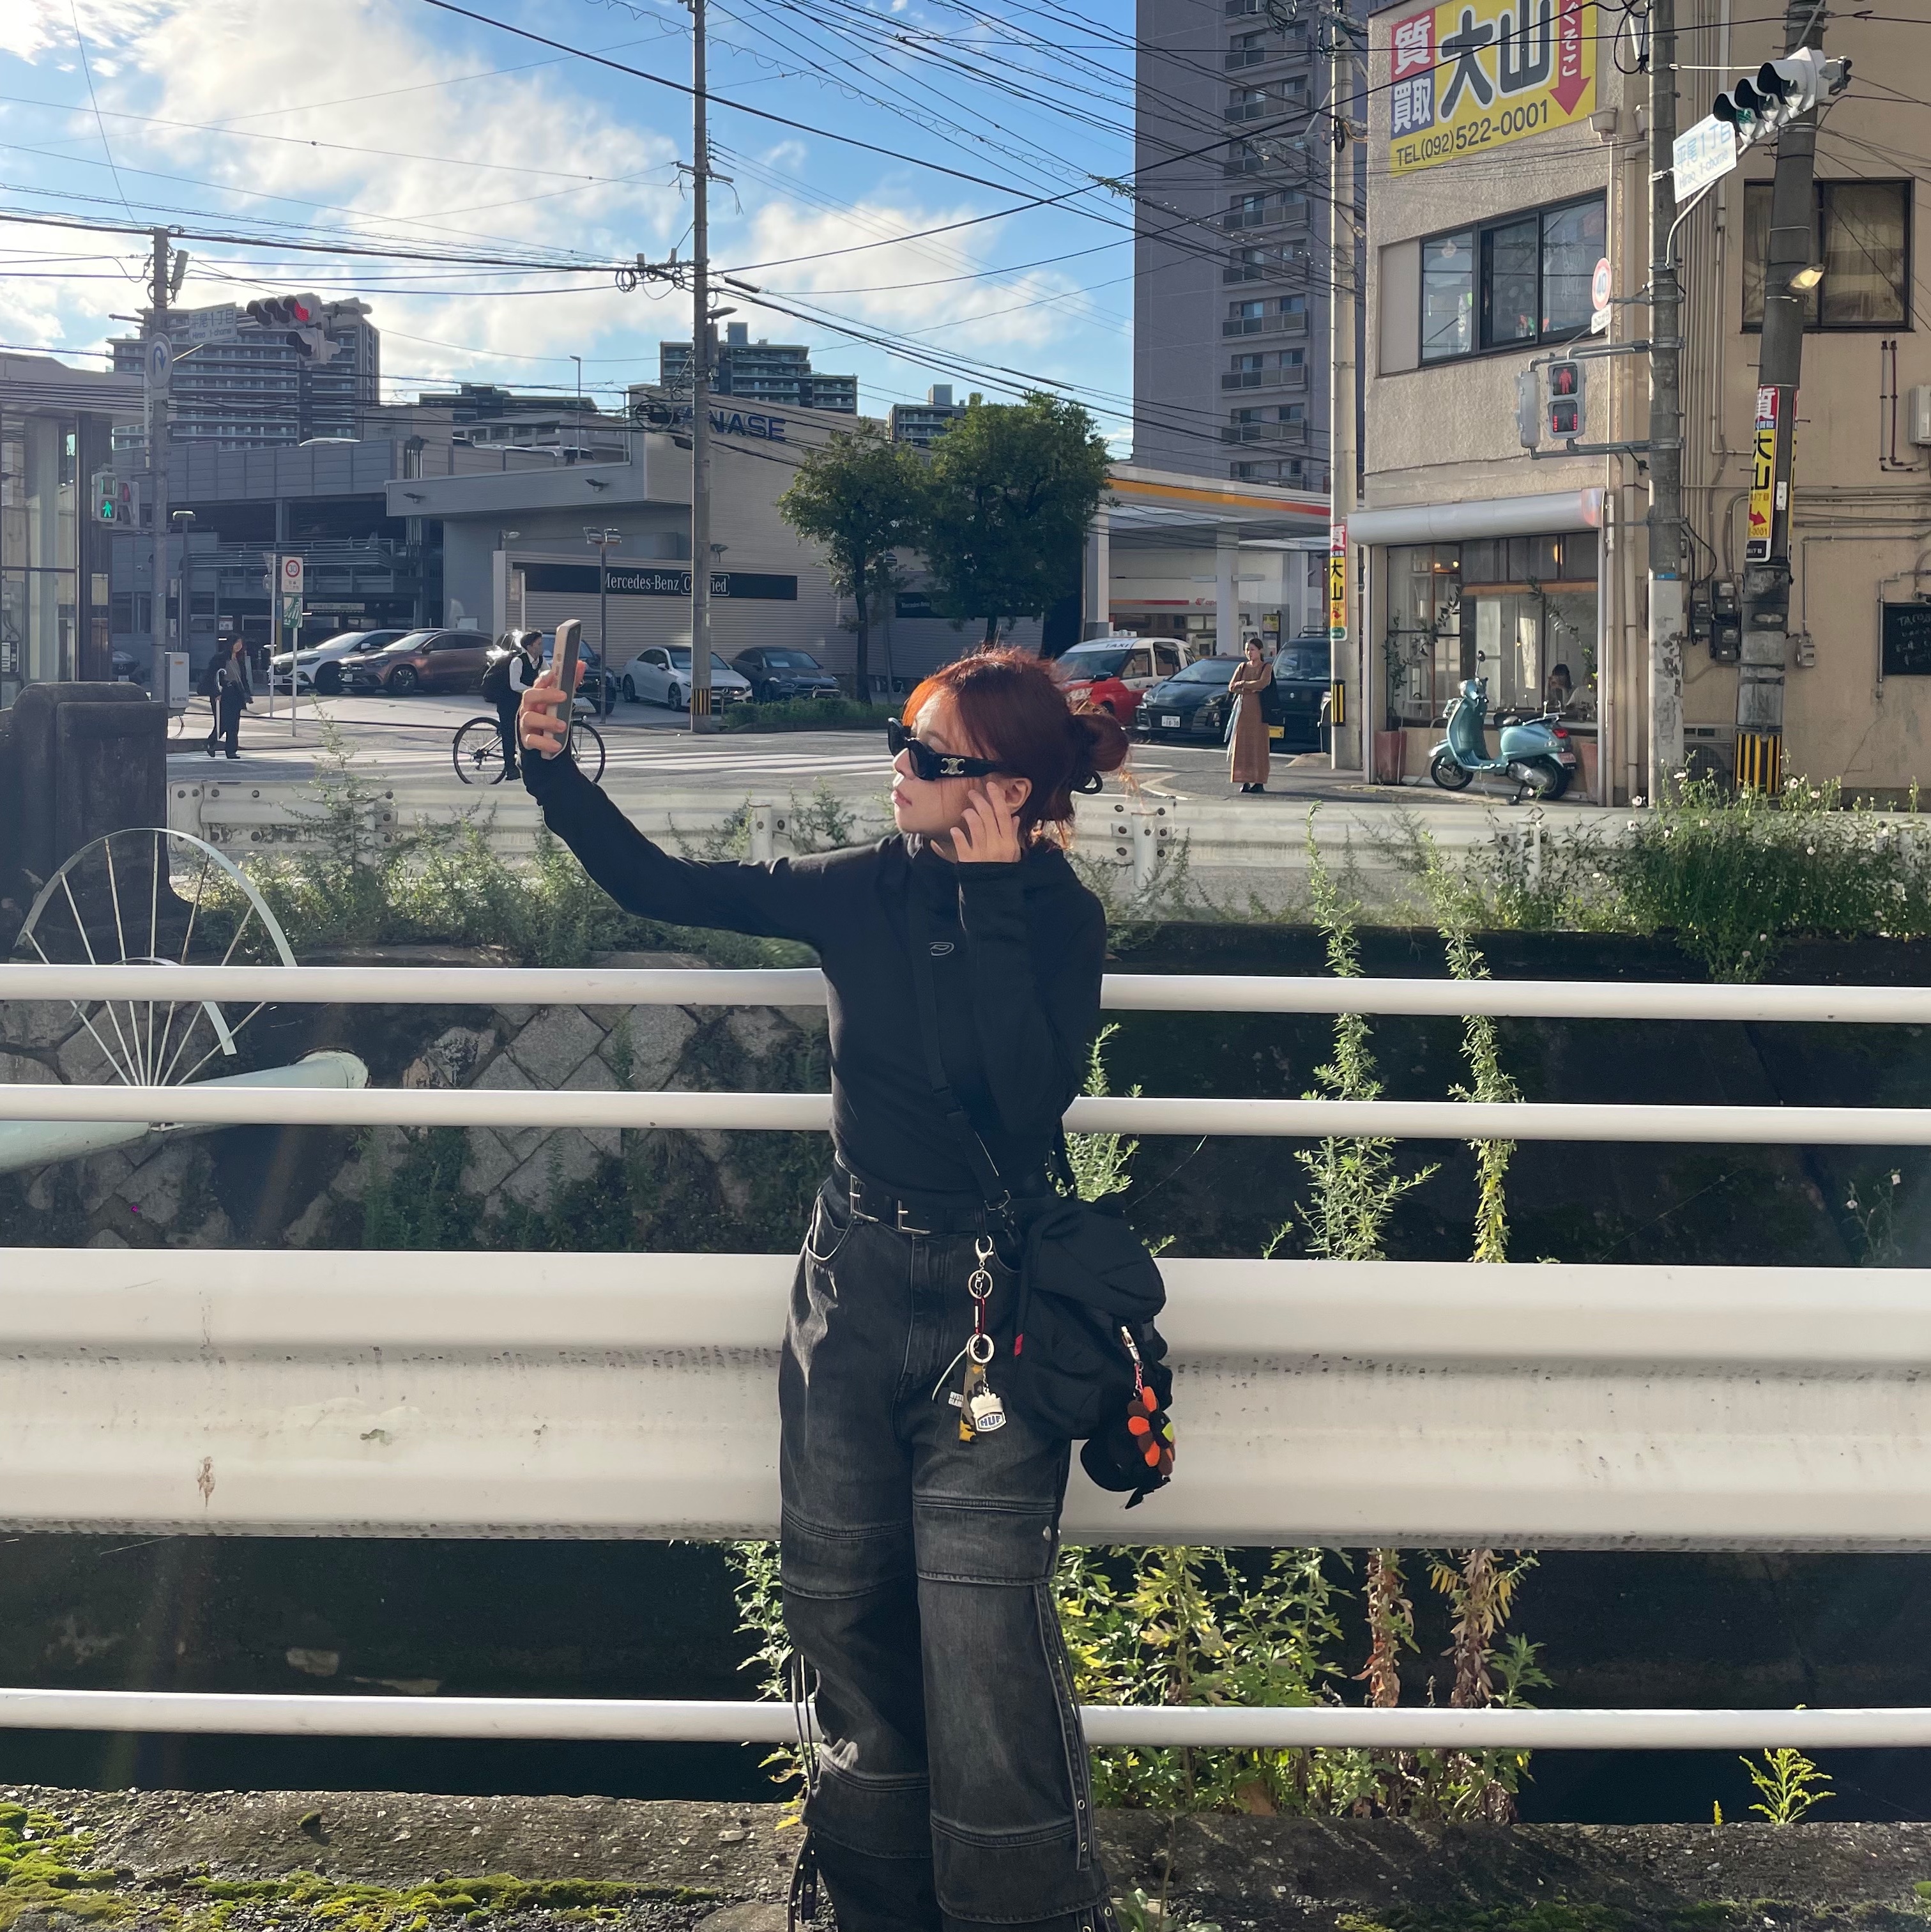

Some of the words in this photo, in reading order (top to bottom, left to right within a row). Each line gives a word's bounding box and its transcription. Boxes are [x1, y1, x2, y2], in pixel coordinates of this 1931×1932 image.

[1394, 15, 1431, 75] 質
[1440, 0, 1552, 120] 大山
[1393, 78, 1431, 134] 買取
[1596, 272, 1607, 296] 40
[191, 309, 234, 329] 平尾1丁目
[288, 564, 297, 573] 30
[1331, 559, 1344, 601] 大山
[605, 572, 679, 591] Mercedes-Benz
[981, 1415, 1001, 1427] HUF
